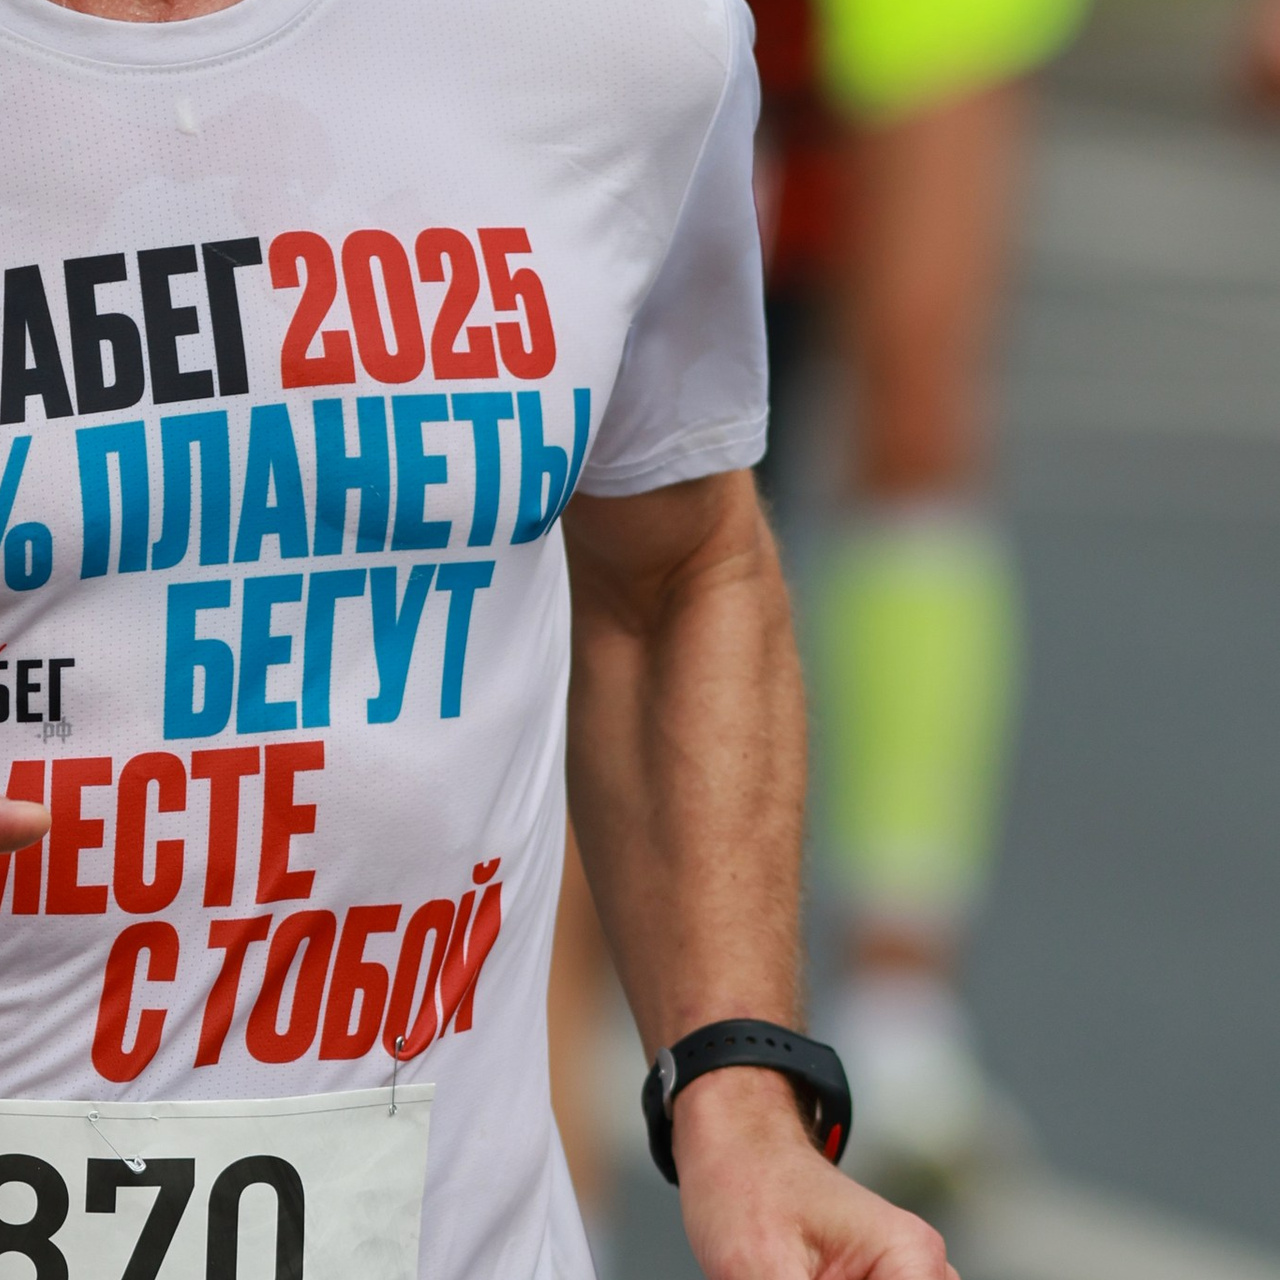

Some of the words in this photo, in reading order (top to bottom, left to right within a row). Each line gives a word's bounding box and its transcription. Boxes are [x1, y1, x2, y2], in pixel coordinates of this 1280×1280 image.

[75, 388, 591, 580] ПЛАНЕТЫ
[163, 560, 495, 740] БЕГУТ
[91, 921, 180, 1084] С
[193, 857, 502, 1069] ТОБОЙ
